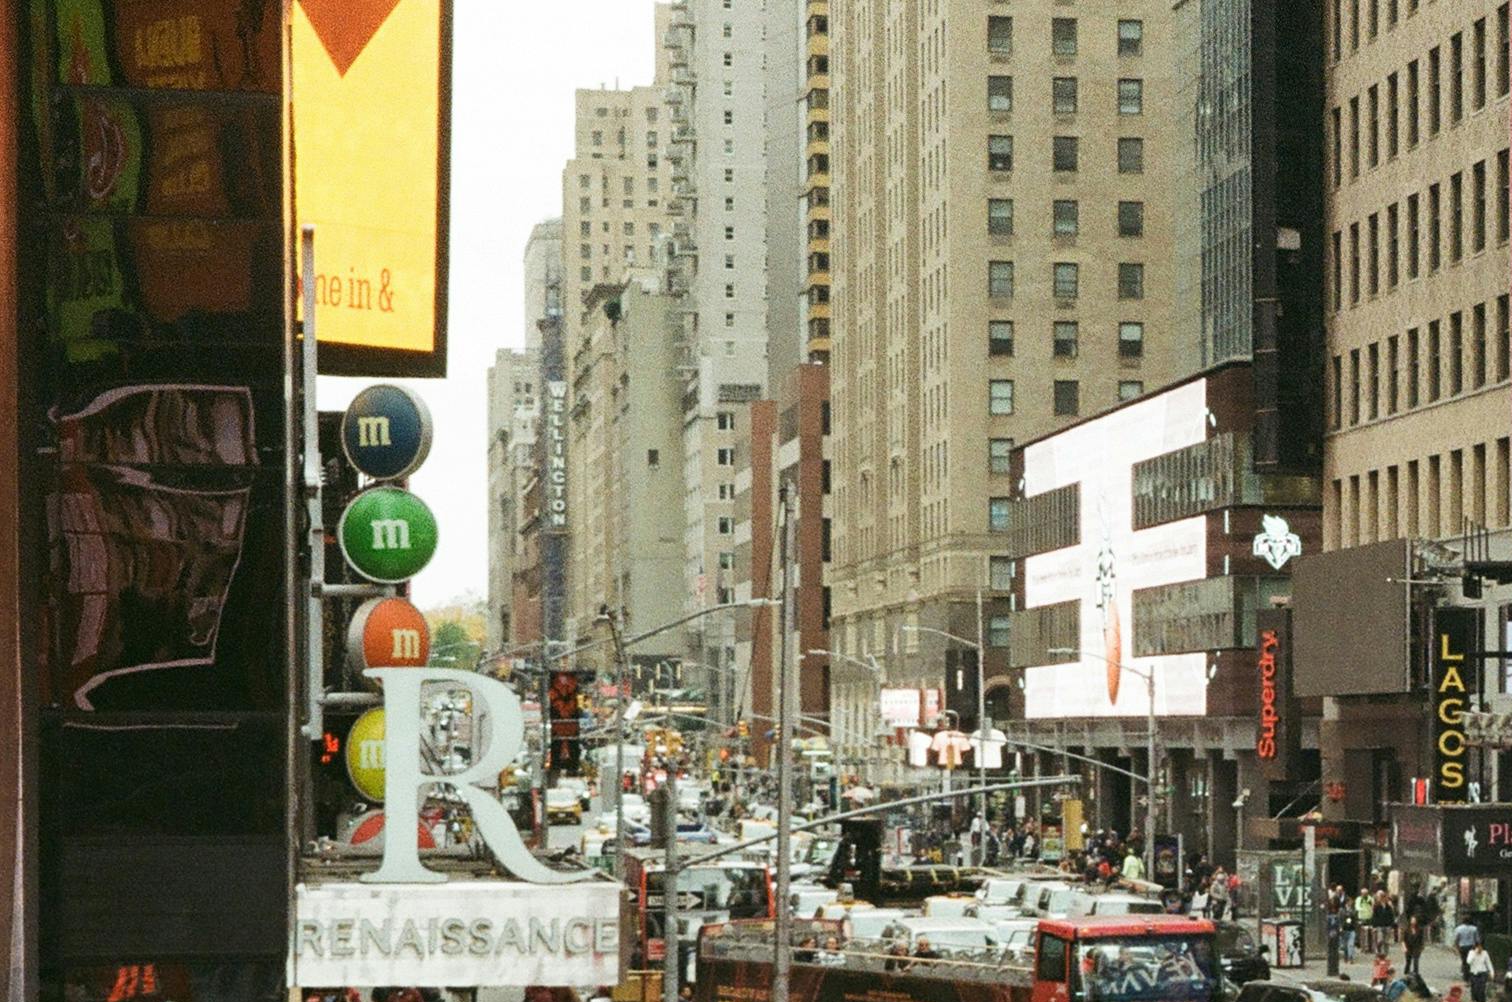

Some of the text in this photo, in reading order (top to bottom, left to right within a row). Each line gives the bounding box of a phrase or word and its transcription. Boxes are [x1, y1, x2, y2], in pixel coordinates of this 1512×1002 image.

[348, 266, 372, 311] in
[378, 267, 395, 313] &
[358, 416, 392, 448] m
[549, 381, 566, 525] WELLINGTON
[370, 518, 412, 550] m
[391, 628, 420, 660] m
[1438, 633, 1467, 788] LAGOS
[359, 666, 600, 884] R
[297, 916, 620, 958] RENAISSANCE
